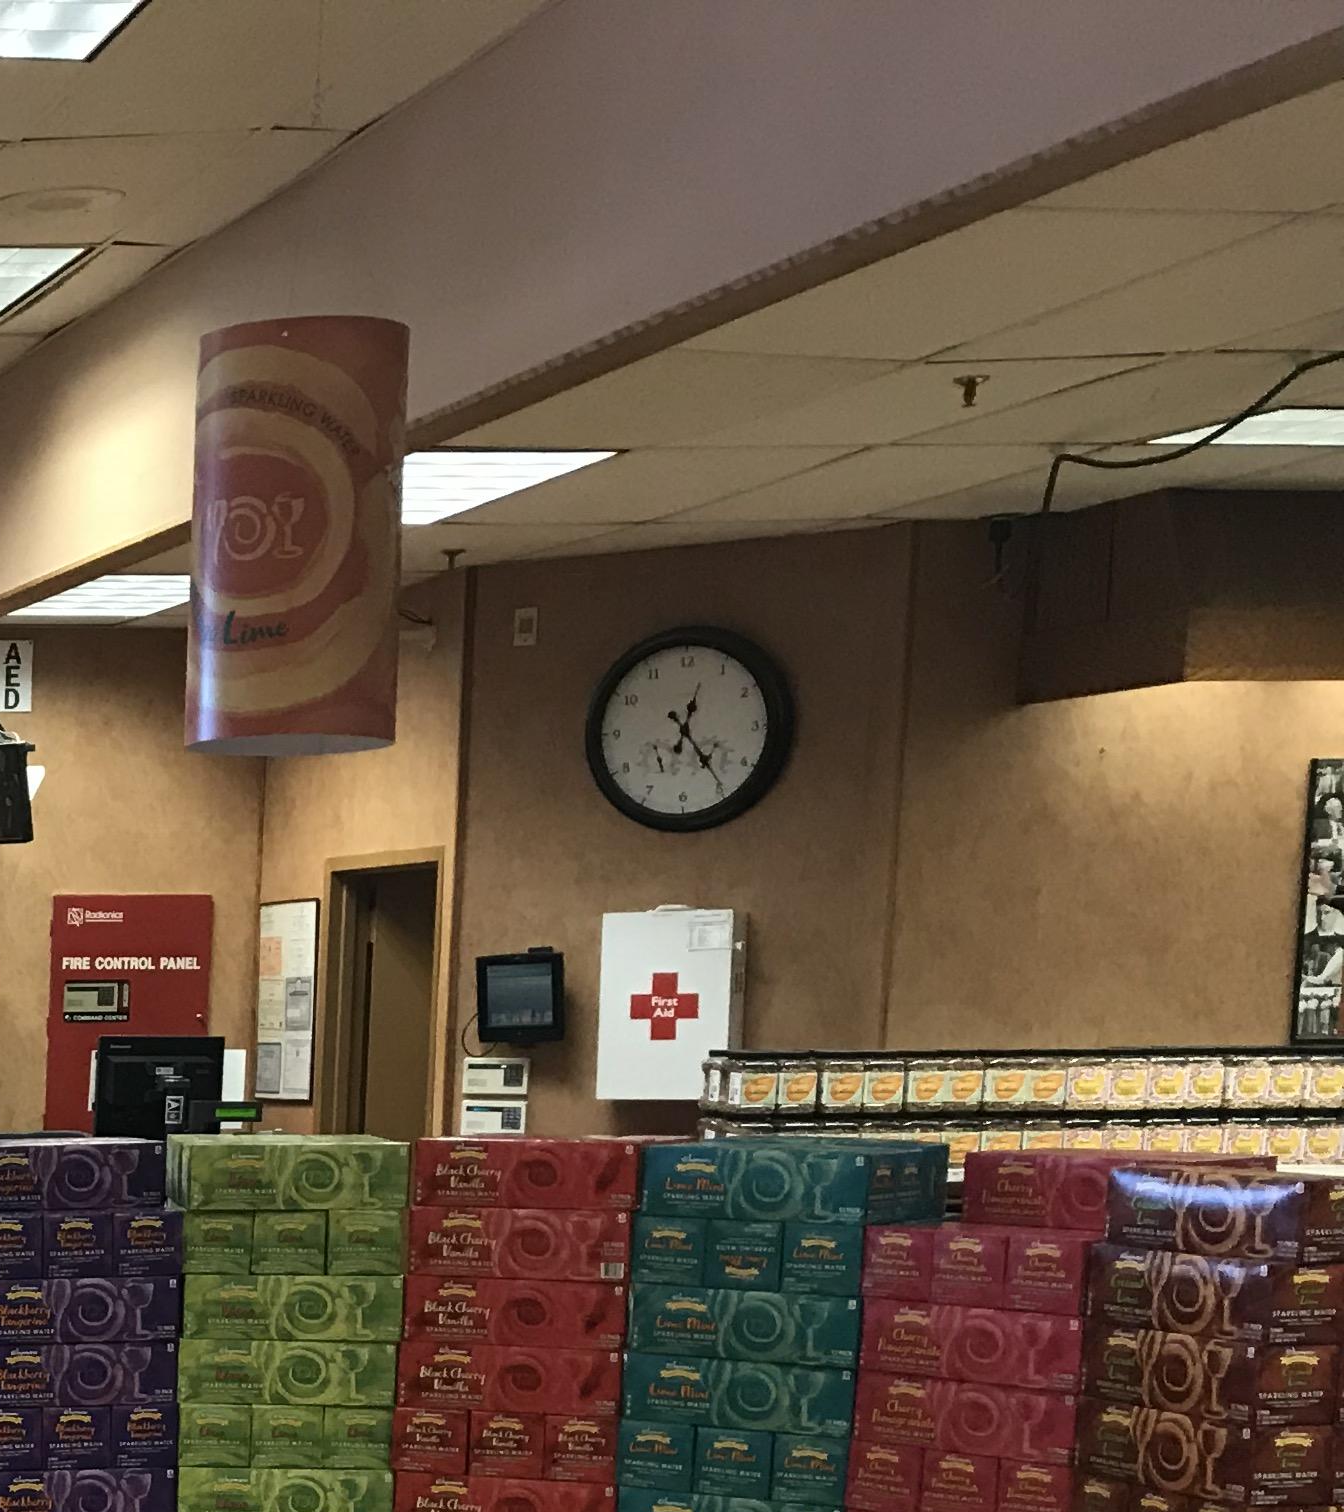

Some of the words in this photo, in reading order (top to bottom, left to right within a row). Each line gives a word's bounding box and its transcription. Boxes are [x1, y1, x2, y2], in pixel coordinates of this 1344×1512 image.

[228, 386, 315, 418] SPARKLING
[318, 410, 363, 459] WATER
[223, 609, 290, 646] Lime
[85, 910, 124, 920] Radionics
[62, 956, 91, 970] FIRE
[95, 956, 156, 970] CONTROL
[159, 956, 201, 970] PANEL
[651, 996, 679, 1008] First
[653, 1007, 675, 1018] Aid
